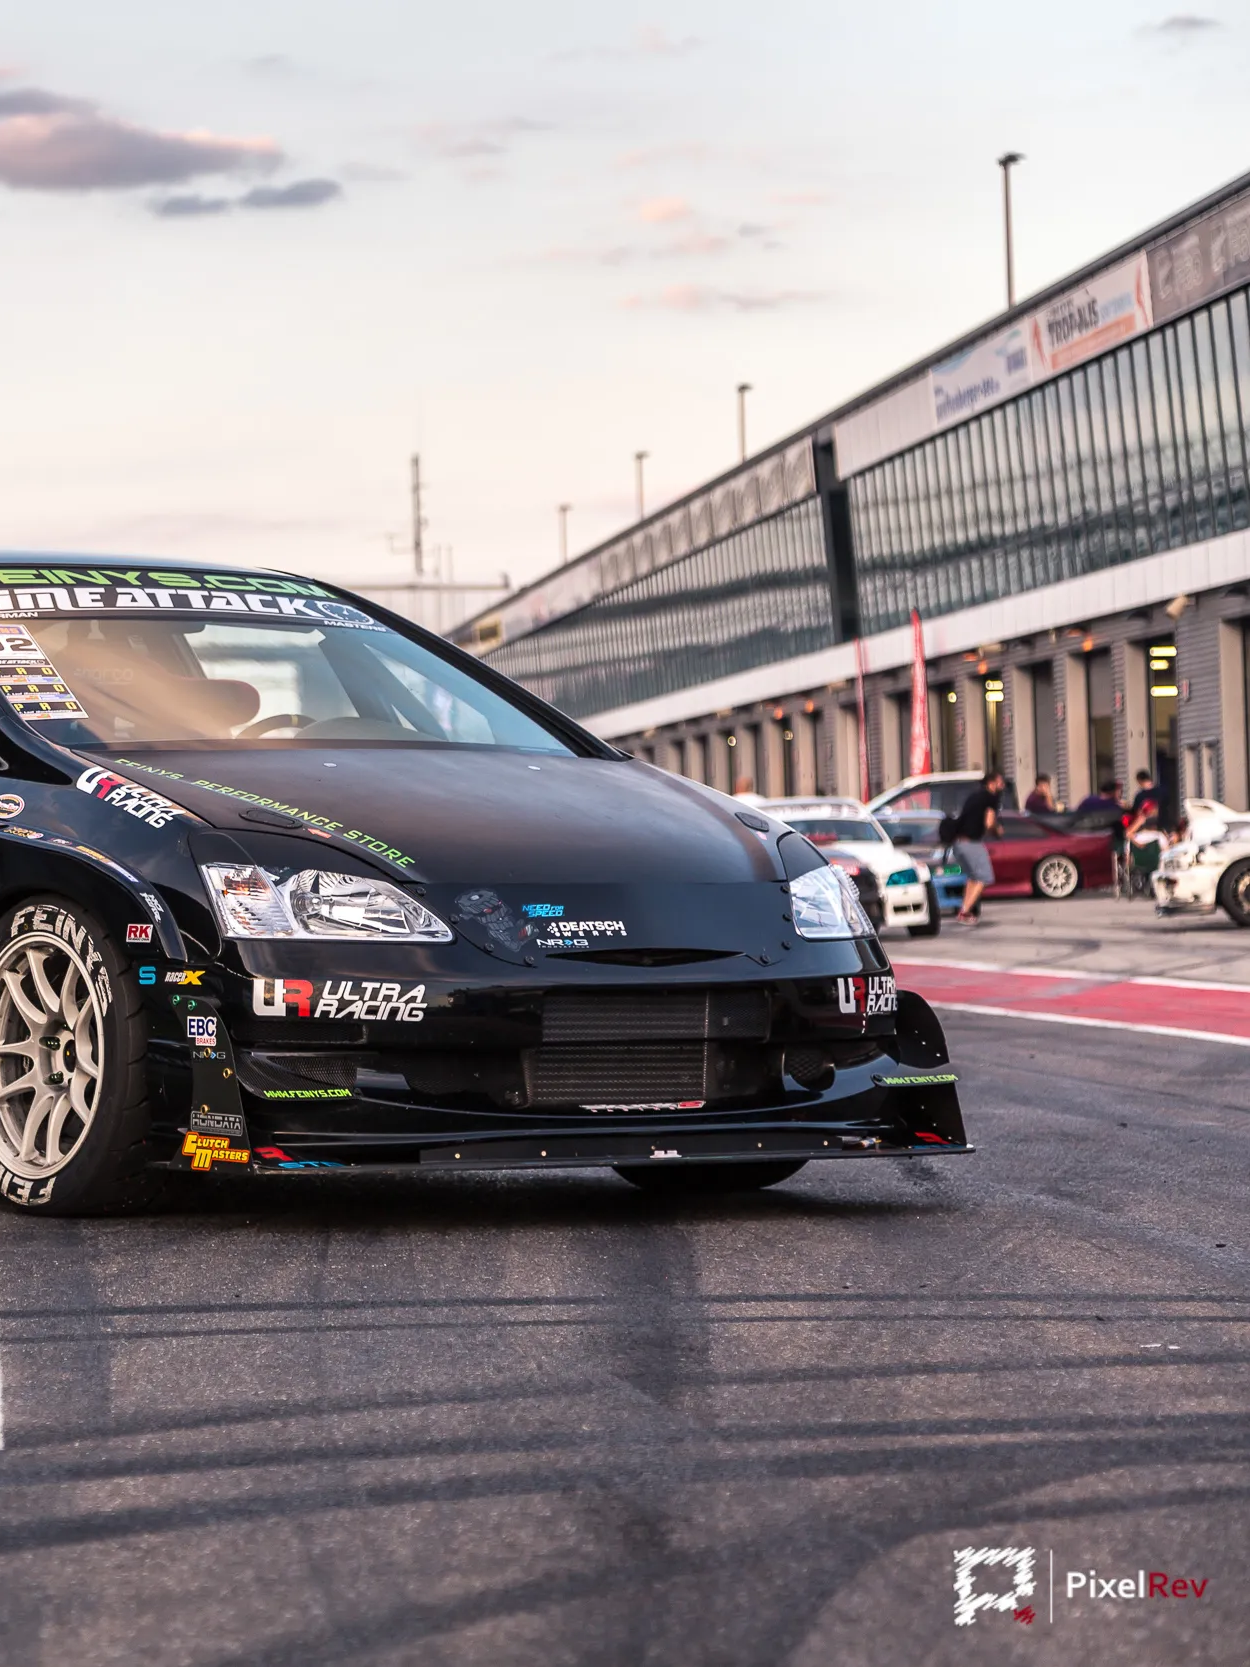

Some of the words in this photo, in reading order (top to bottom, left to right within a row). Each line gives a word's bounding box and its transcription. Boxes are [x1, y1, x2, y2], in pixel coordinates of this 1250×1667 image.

[323, 620, 387, 632] MASTERS
[105, 788, 174, 829] RACING
[119, 782, 187, 819] ULTRA
[115, 758, 184, 781] FEINYS
[190, 778, 344, 832] PERFORMANCE
[343, 829, 416, 869] STORE
[128, 926, 151, 938] RK
[558, 921, 625, 932] DEATSCH
[321, 980, 426, 1004] ULTRA
[314, 1001, 428, 1022] RACING
[189, 1018, 215, 1037] EBC
[263, 1088, 353, 1099] WWW.FEINYS.COM
[183, 1134, 228, 1154] CLUTCH
[193, 1148, 249, 1168] MASTERS
